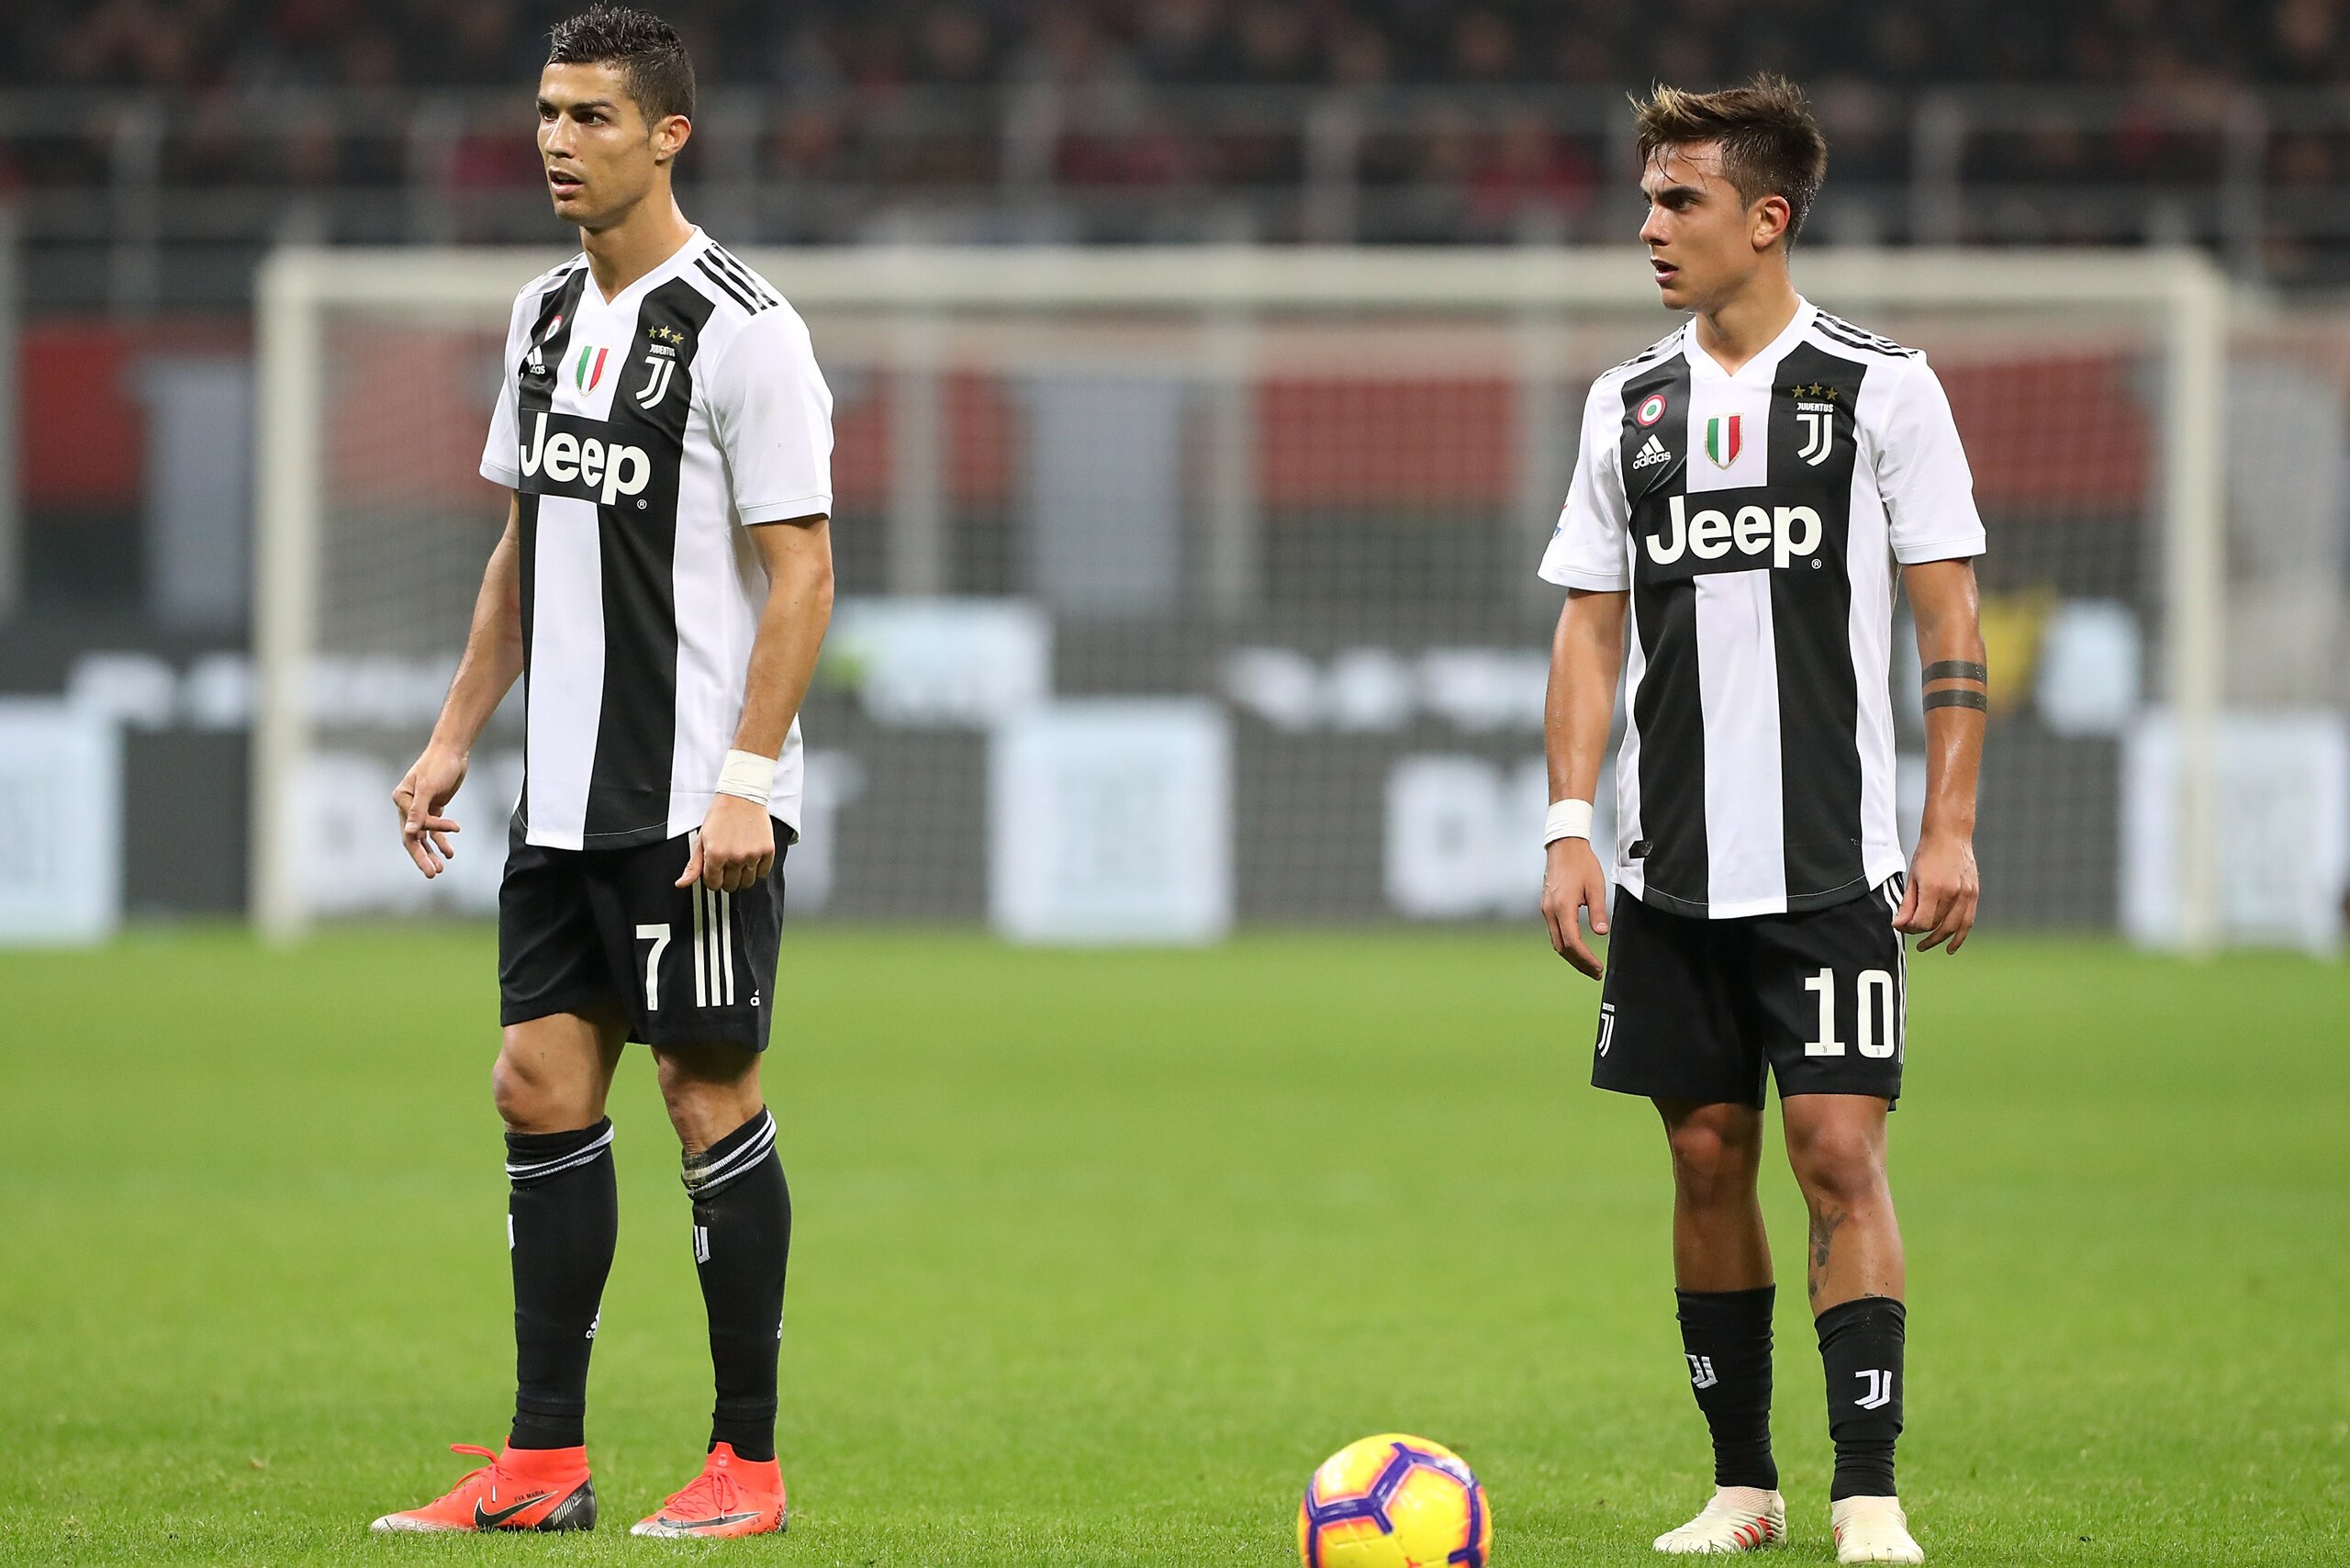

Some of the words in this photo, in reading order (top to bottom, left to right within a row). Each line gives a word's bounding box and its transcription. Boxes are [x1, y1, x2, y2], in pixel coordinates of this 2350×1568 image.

[1796, 402, 1834, 412] JUVENTUS
[520, 412, 651, 506] Jeep
[1632, 451, 1672, 470] adidas
[1646, 495, 1822, 568] Jeep
[635, 924, 671, 1011] 7
[1804, 968, 1895, 1058] 10
[514, 1494, 525, 1503] EVA
[525, 1488, 545, 1498] MARIA
